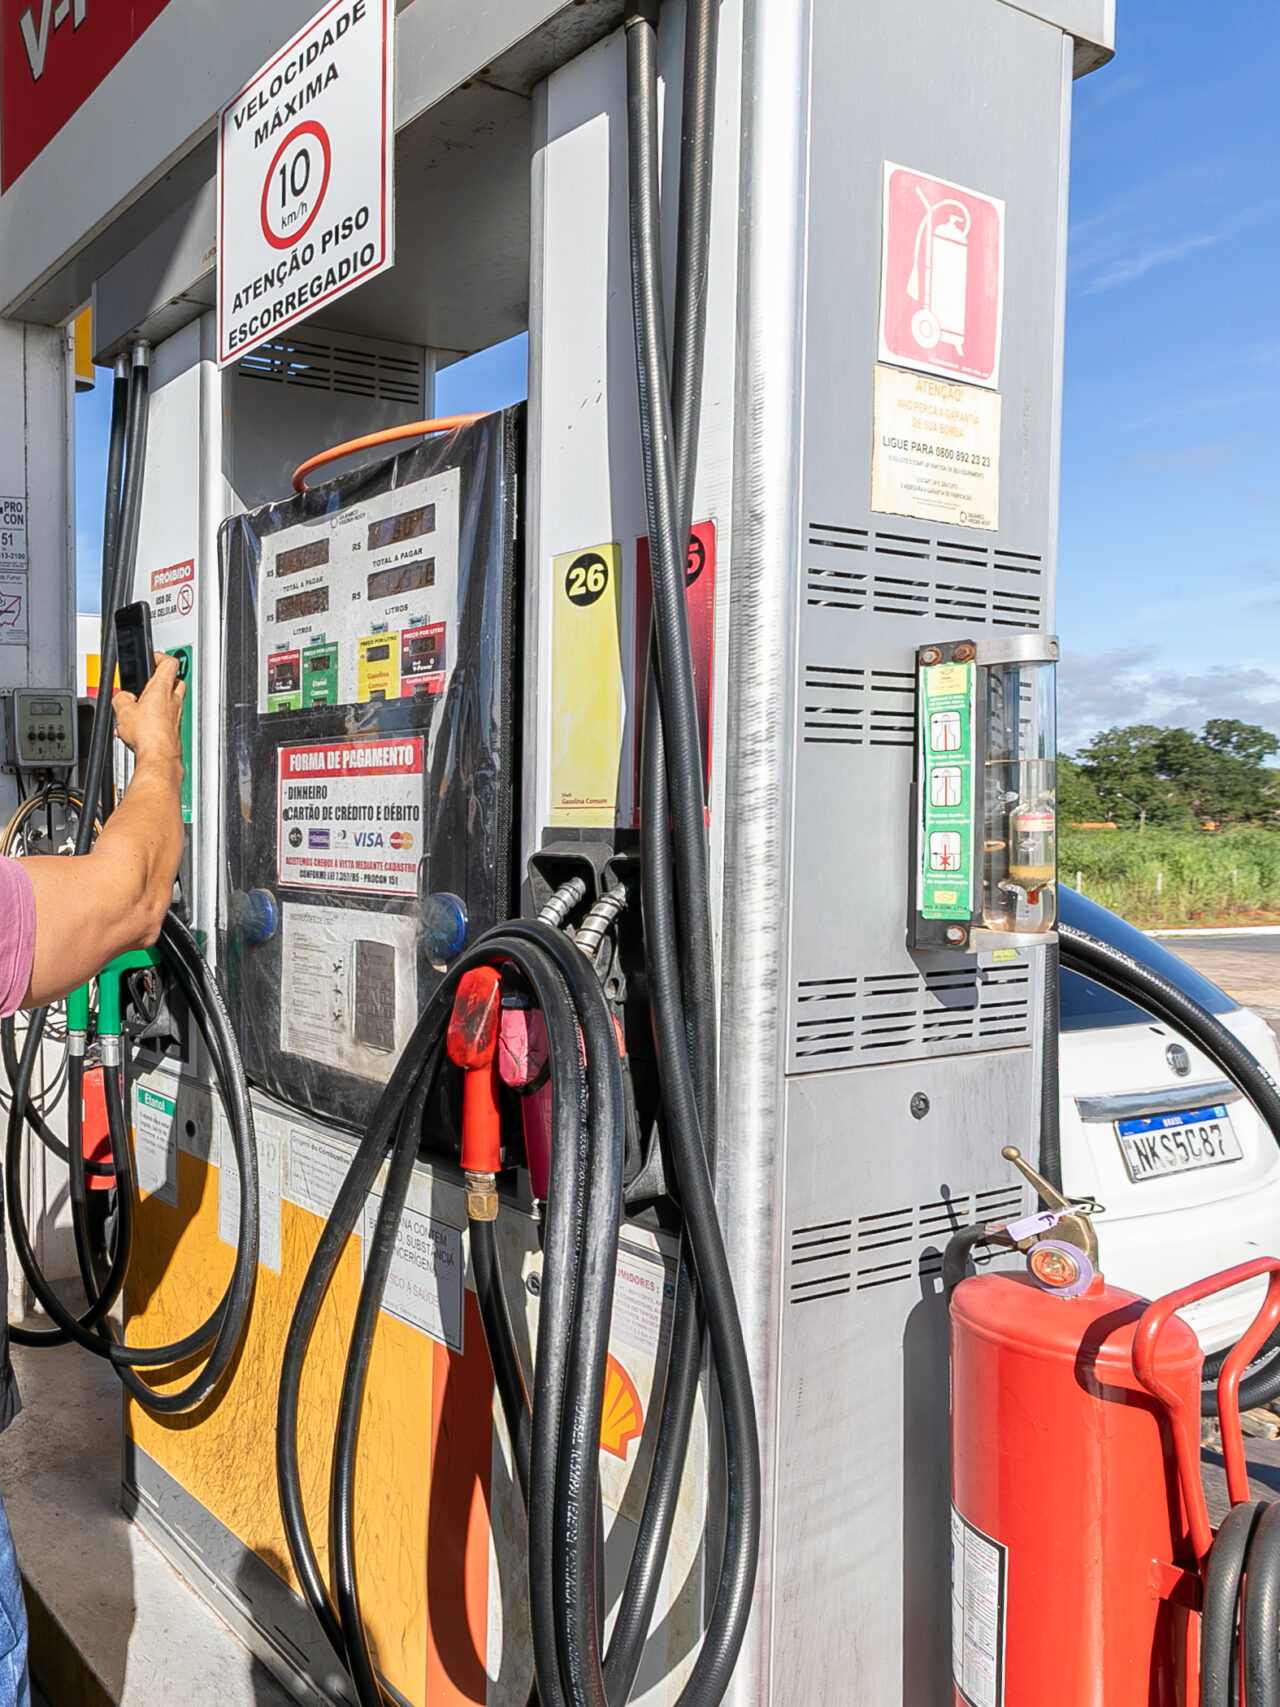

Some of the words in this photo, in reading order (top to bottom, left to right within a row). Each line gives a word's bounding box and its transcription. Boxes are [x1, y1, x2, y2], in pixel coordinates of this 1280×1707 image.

[232, 0, 367, 131] VELOCIDADE
[253, 60, 339, 149] MÁXIMA
[278, 147, 311, 208] 10
[279, 200, 309, 230] km/h
[231, 246, 315, 314] ATENÇÃO
[320, 205, 371, 256] PISO
[227, 242, 376, 351] ESCORREGADIO
[883, 435, 908, 451] LIGUE
[911, 441, 933, 455] PARA
[936, 446, 954, 460] 0800
[956, 451, 969, 463] 892
[971, 454, 980, 465] 23
[982, 456, 991, 467] 23
[4, 501, 23, 513] PRO
[3, 513, 24, 525] CON
[372, 555, 392, 568] TOTAL
[400, 547, 423, 559] PAGAR
[154, 565, 192, 587] PROIBIDO
[568, 562, 605, 597] 26
[165, 593, 172, 602] DE
[283, 582, 299, 592] TOTAL
[385, 604, 408, 615] LITROS
[293, 626, 312, 636] LITROS
[289, 752, 326, 772] FORMA
[327, 750, 340, 770] DE
[342, 744, 414, 769] PAGAMENTO
[288, 785, 328, 800] DINHEIRO
[287, 804, 320, 821] CARTÃO
[322, 806, 333, 820] DE
[335, 803, 374, 820] CRÉDITO
[376, 806, 381, 820] E
[383, 802, 420, 821] DÉBITO
[352, 832, 384, 848] VISA
[313, 858, 333, 868] CHEQUE
[339, 860, 354, 868] VISTA
[355, 861, 383, 871] MEDIANTE
[384, 863, 416, 873] CADASTRO
[300, 870, 326, 879] CONFORME
[364, 874, 387, 885] PROCON
[388, 876, 398, 885] 151
[144, 1093, 166, 1112] Etanol
[1162, 1116, 1183, 1127] BRASIL
[1133, 1123, 1225, 1172] NKS5C87
[413, 1220, 447, 1246] CONTÉM
[412, 1284, 439, 1306] SAÚDE
